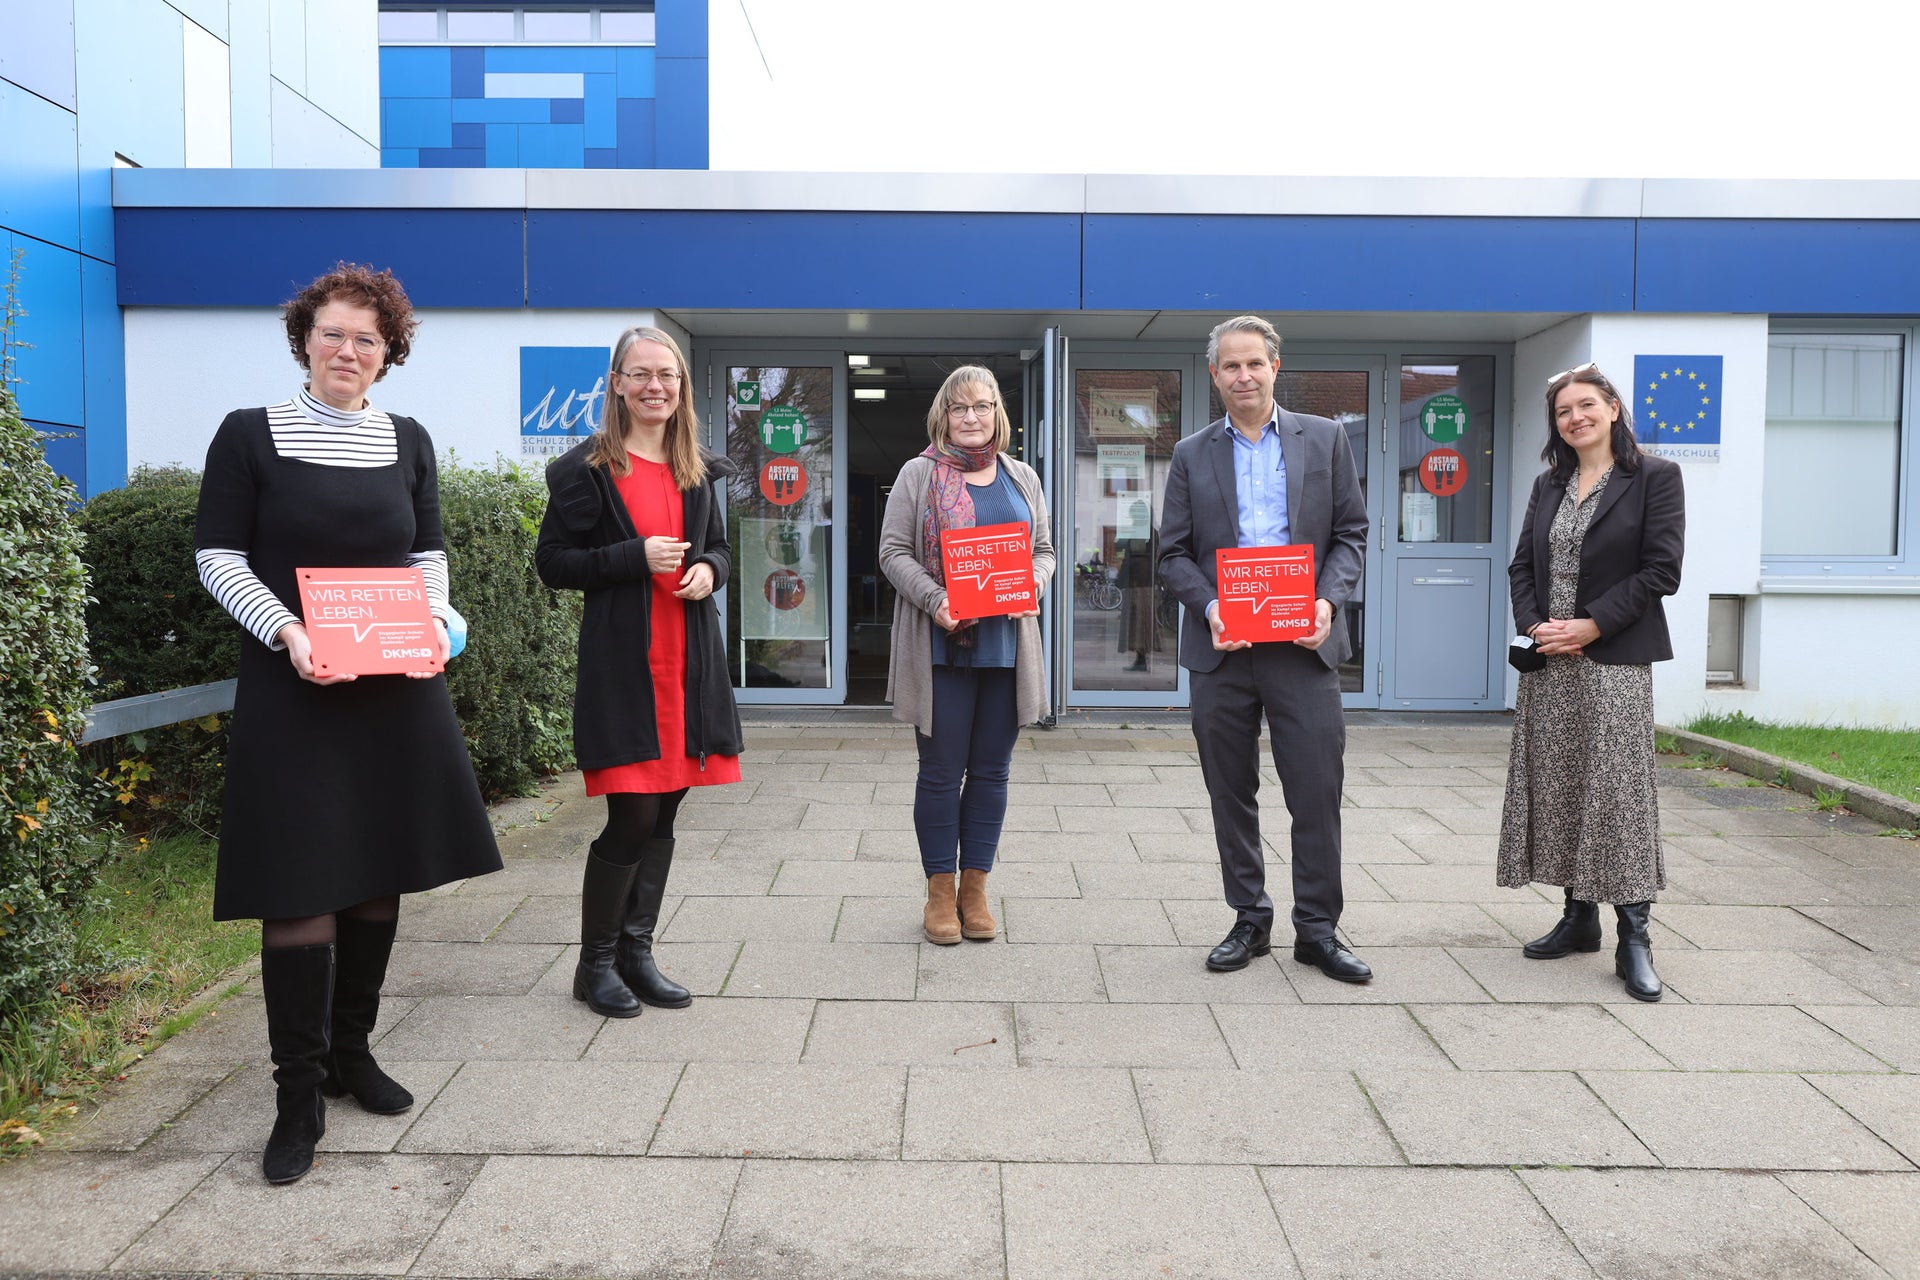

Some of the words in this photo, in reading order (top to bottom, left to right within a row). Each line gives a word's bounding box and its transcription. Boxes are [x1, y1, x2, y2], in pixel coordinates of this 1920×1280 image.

[1428, 456, 1459, 464] ABSTAND
[768, 473, 799, 481] HALTEN!
[947, 546, 974, 558] WIR
[977, 540, 1027, 555] RETTEN
[949, 559, 995, 573] LEBEN.
[1222, 566, 1251, 578] WIR
[1254, 564, 1309, 577] RETTEN
[308, 589, 347, 602] WIR
[351, 588, 421, 602] RETTEN
[1223, 581, 1273, 595] LEBEN.
[995, 592, 1022, 603] DKMS
[311, 606, 378, 620] LEBEN.
[1271, 618, 1301, 628] DKMS
[382, 648, 421, 659] DKMS
